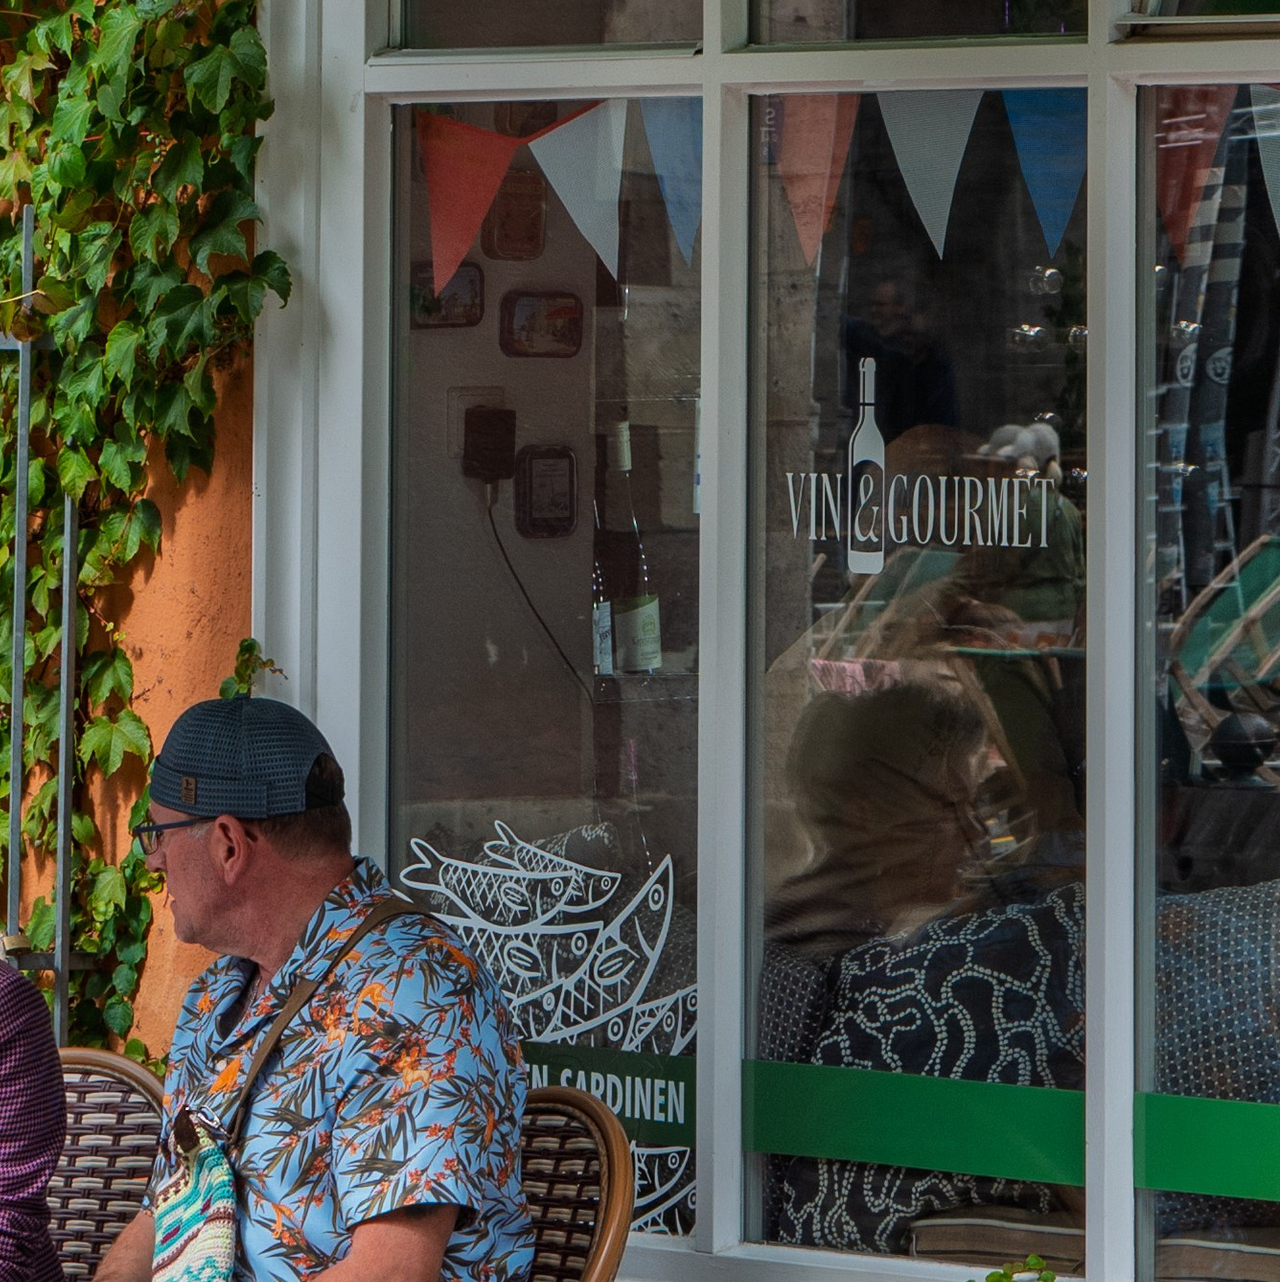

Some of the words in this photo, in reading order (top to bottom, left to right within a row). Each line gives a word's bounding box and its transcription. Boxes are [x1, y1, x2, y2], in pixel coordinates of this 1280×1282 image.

[785, 472, 843, 542] VIN
[854, 474, 880, 543] &
[888, 474, 1055, 548] GOURMET
